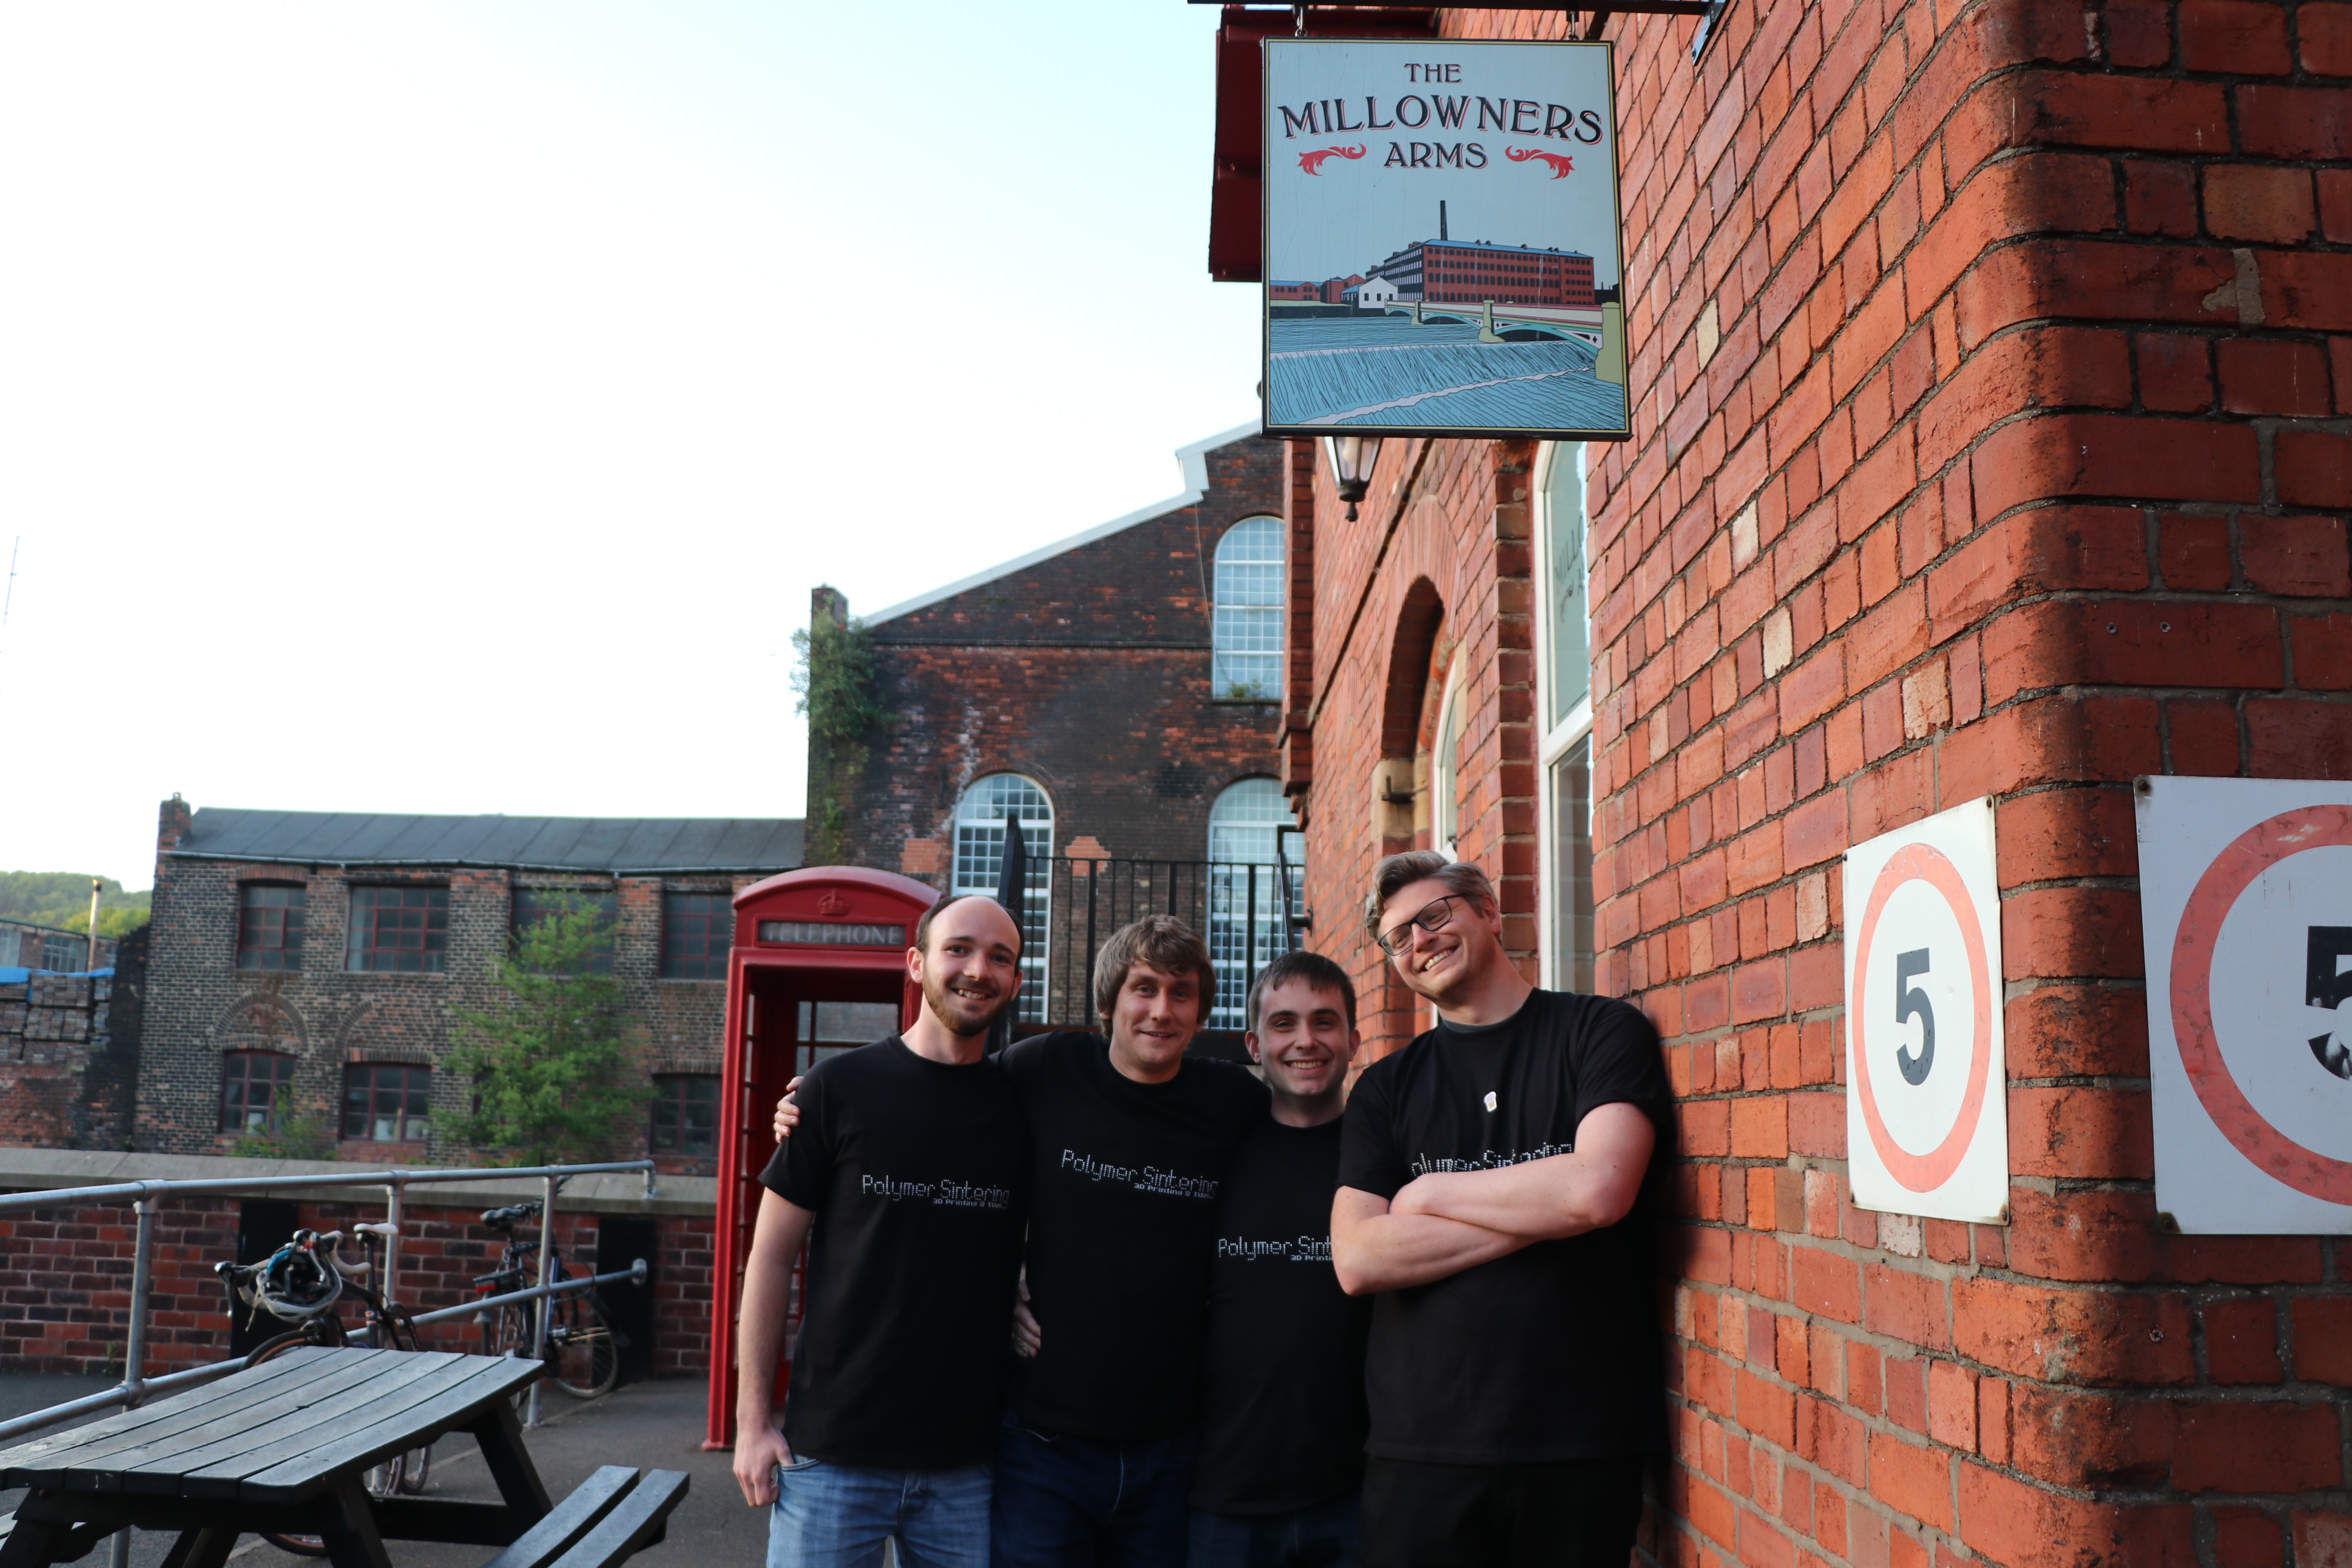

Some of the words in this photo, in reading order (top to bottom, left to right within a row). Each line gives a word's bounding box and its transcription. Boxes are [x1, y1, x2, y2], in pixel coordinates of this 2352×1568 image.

[1404, 63, 1463, 83] THE
[1277, 94, 1604, 145] MILLOWNERS
[1384, 141, 1488, 169] ARMS
[765, 922, 900, 944] TELEPHONE
[1896, 947, 1935, 1086] 5
[1062, 1149, 1138, 1181] Polymer
[862, 1175, 936, 1201] Polymer
[940, 1179, 1010, 1209] Sintering
[1147, 1185, 1183, 1196] Printing
[1219, 1236, 1293, 1260] Polymer
